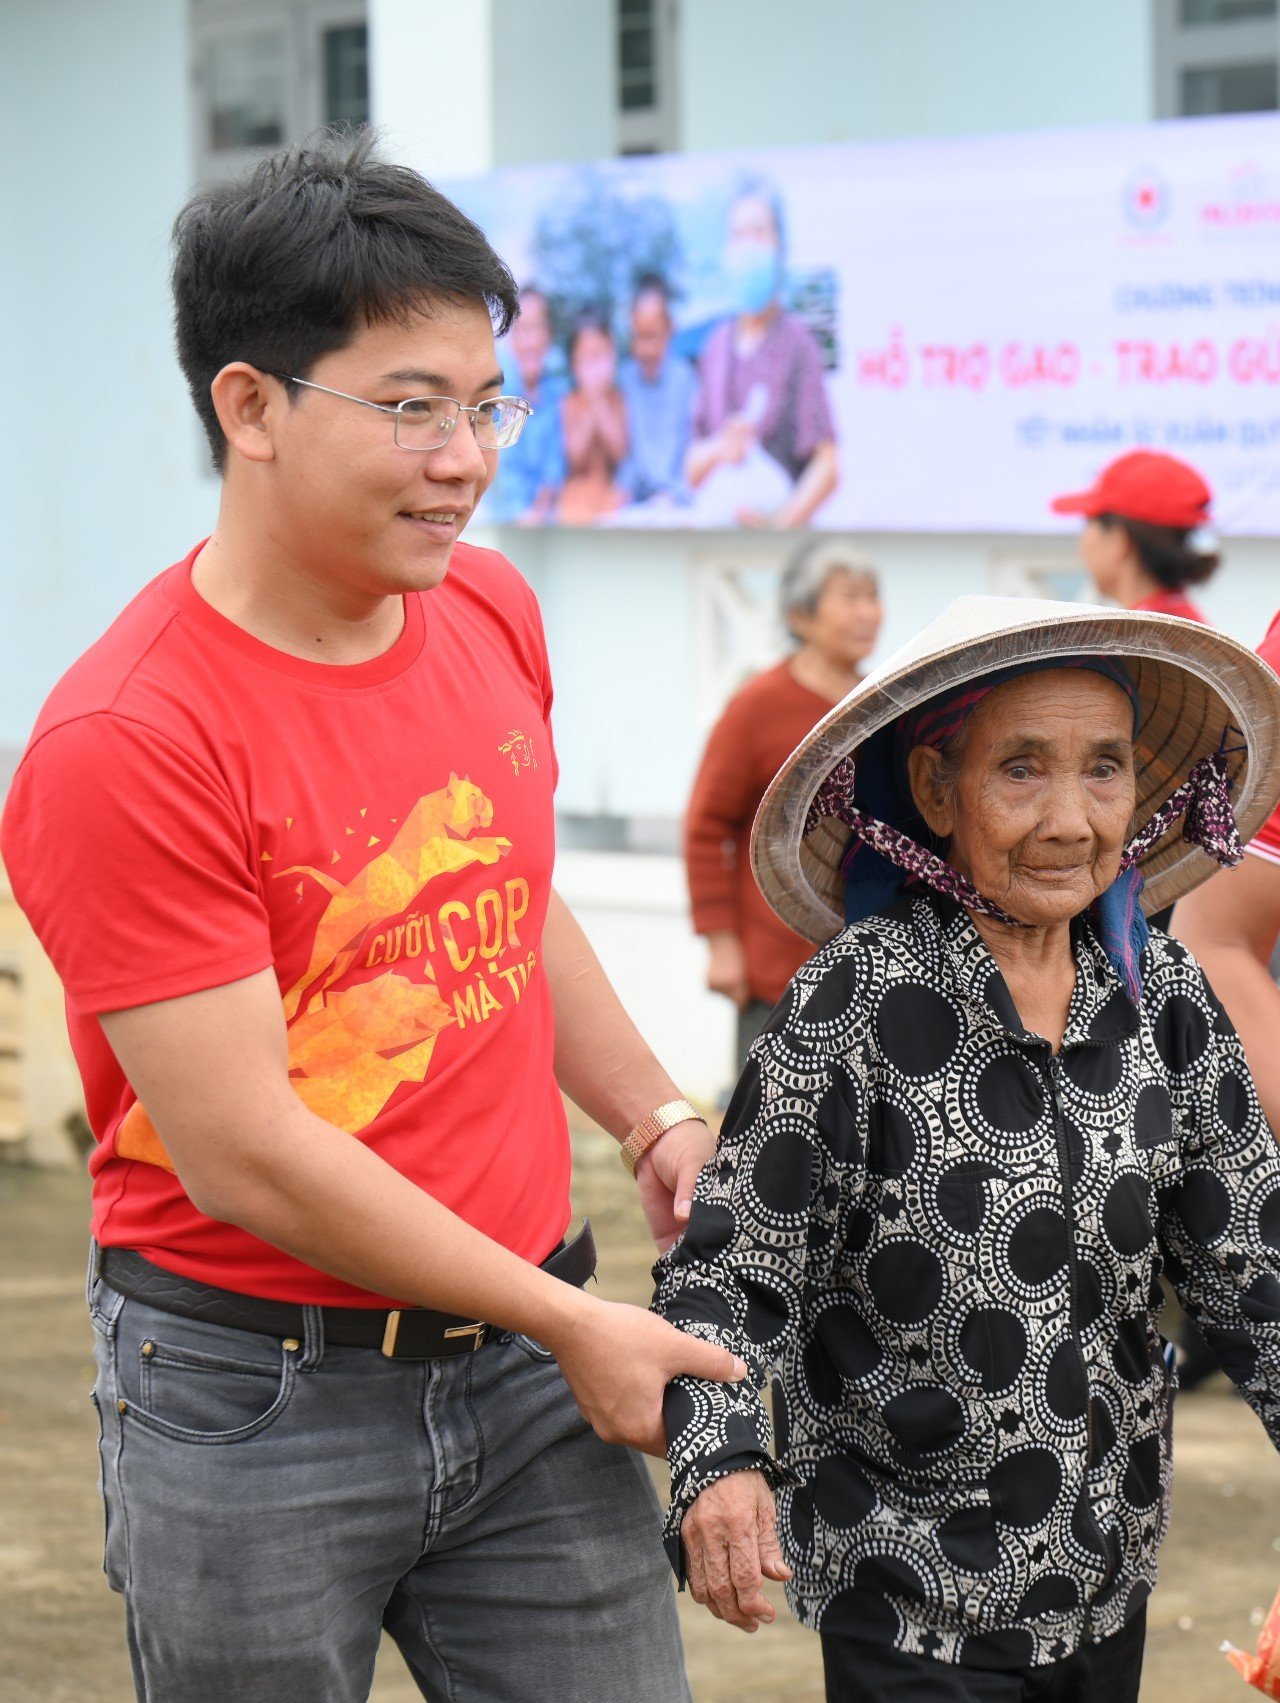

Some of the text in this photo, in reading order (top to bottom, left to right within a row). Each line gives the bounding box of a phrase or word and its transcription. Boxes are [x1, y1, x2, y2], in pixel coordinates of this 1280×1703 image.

[1113, 340, 1217, 384] TRAO
[365, 877, 530, 974] CƯỠI CỌP
[453, 971, 503, 1029] MÀ
